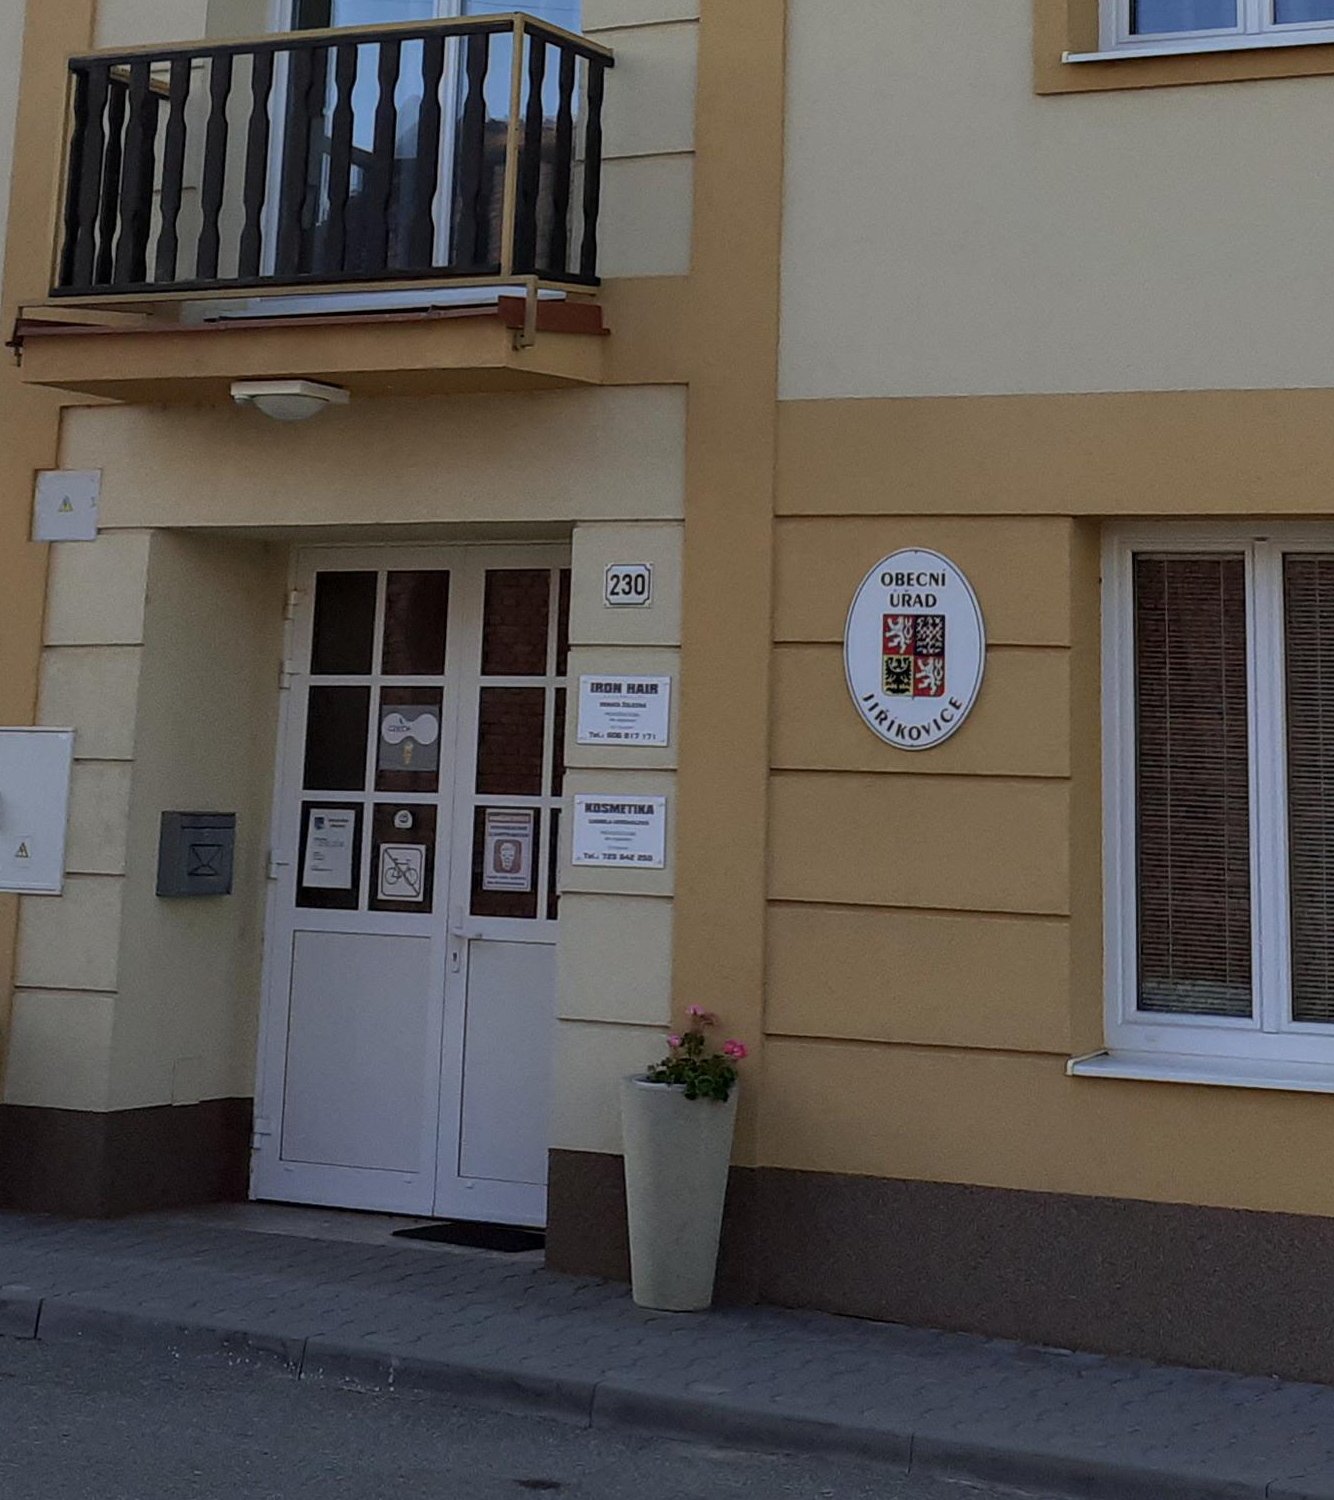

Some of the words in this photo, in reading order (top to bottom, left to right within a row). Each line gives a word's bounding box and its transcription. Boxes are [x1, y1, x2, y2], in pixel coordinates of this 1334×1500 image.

[609, 573, 645, 596] 230
[880, 568, 947, 587] OBECNÍ
[889, 588, 938, 608] ÚŘAD
[590, 682, 622, 693] IRON
[626, 683, 659, 694] HAIR
[861, 693, 963, 742] JIŘÍKOVICE
[584, 802, 654, 814] KOSMETIKA
